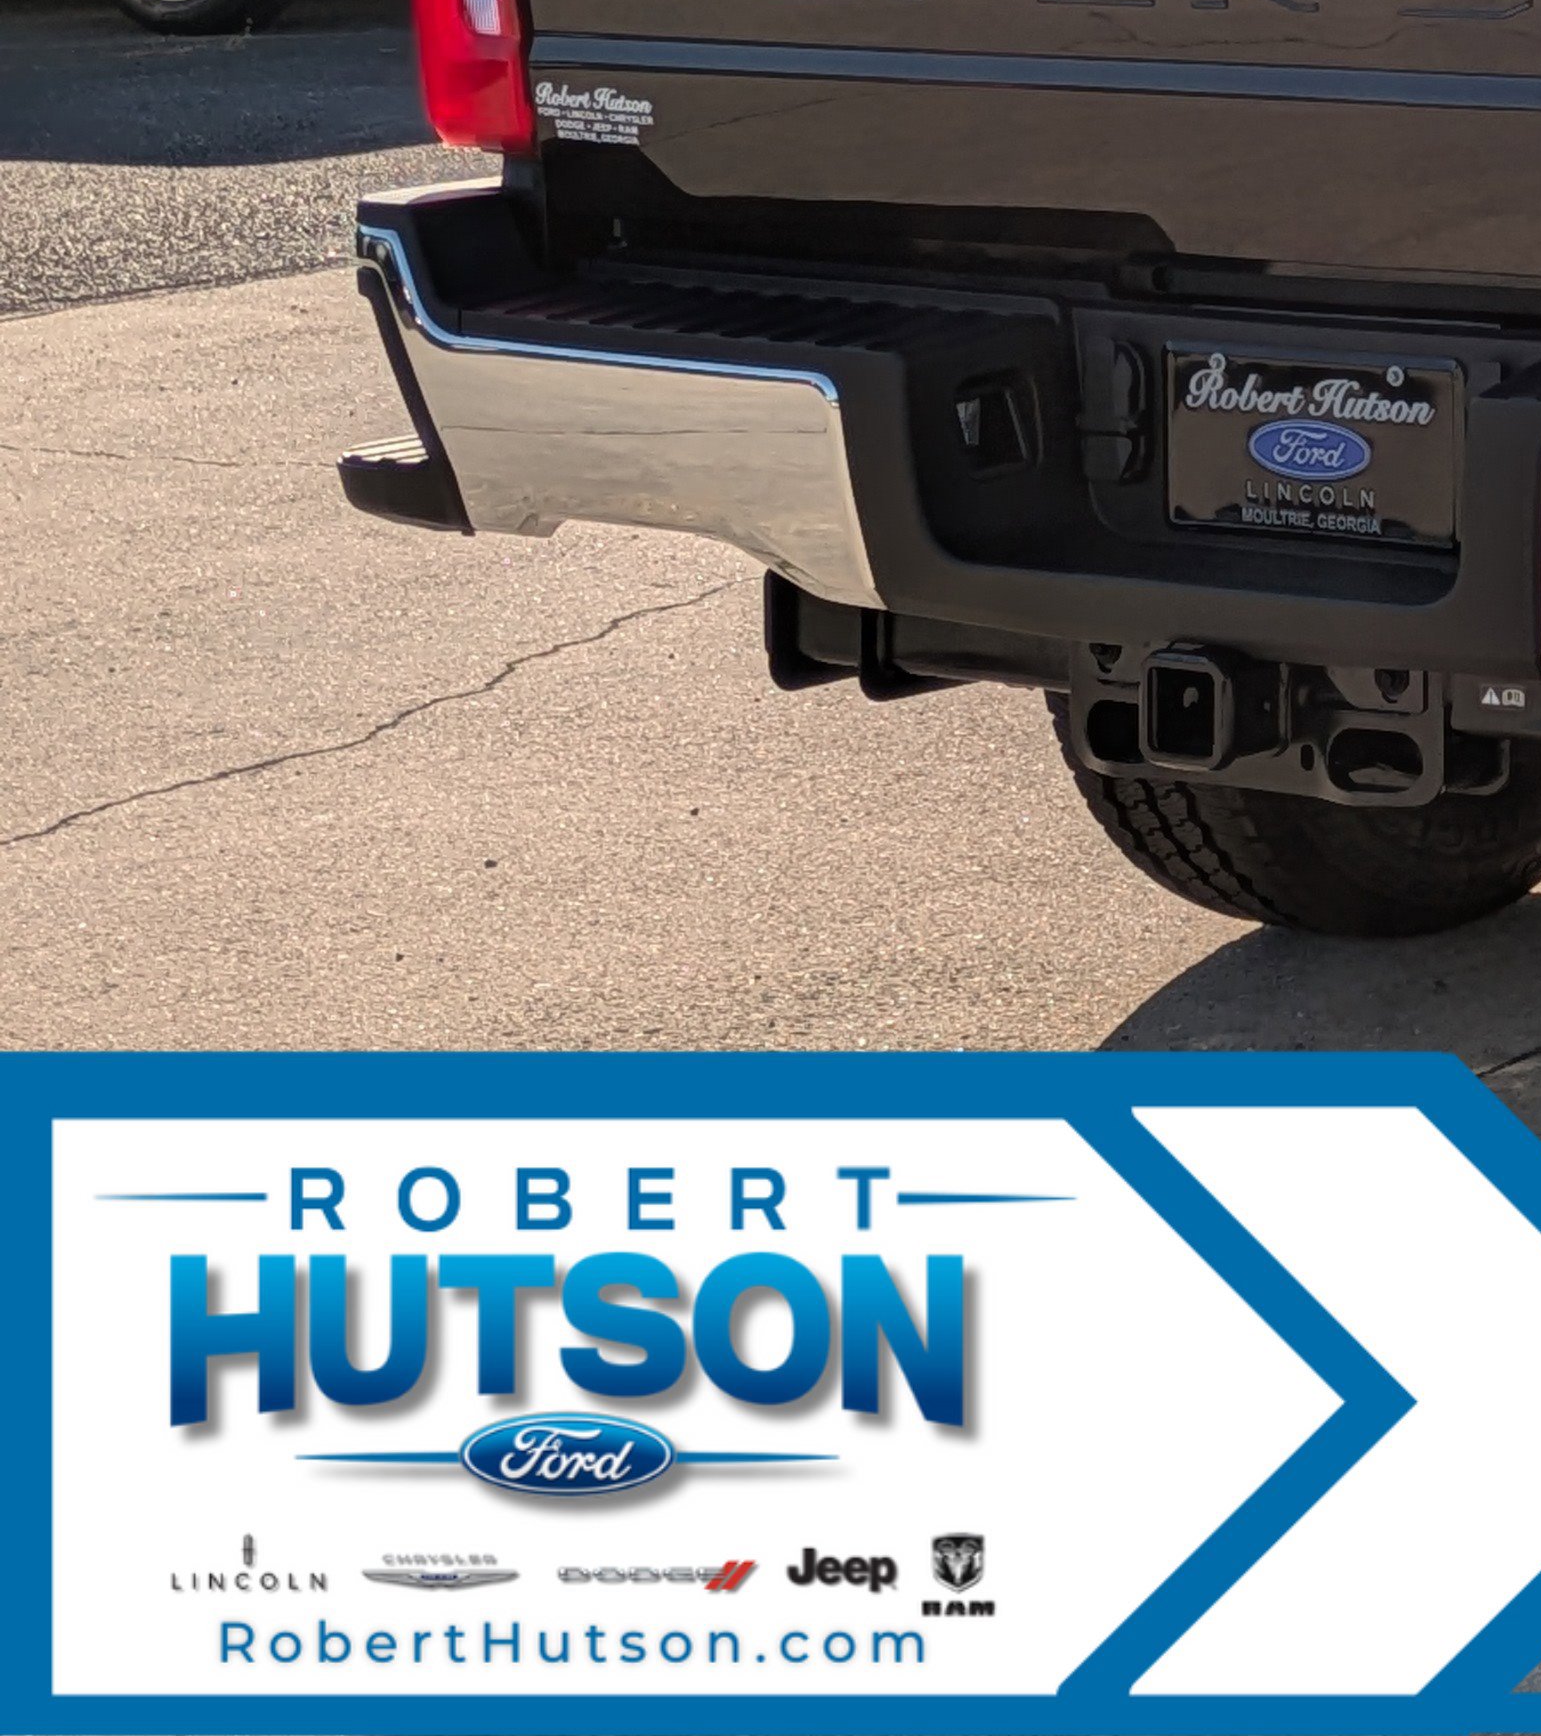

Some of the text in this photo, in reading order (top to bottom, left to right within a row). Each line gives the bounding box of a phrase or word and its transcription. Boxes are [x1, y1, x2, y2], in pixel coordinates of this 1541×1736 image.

[535, 81, 653, 114] Robert Hutson
[1185, 366, 1435, 425] Robert Hutson
[1272, 428, 1345, 468] Ford
[1246, 480, 1374, 508] LINCOLN
[1317, 513, 1382, 535] GEORGIA
